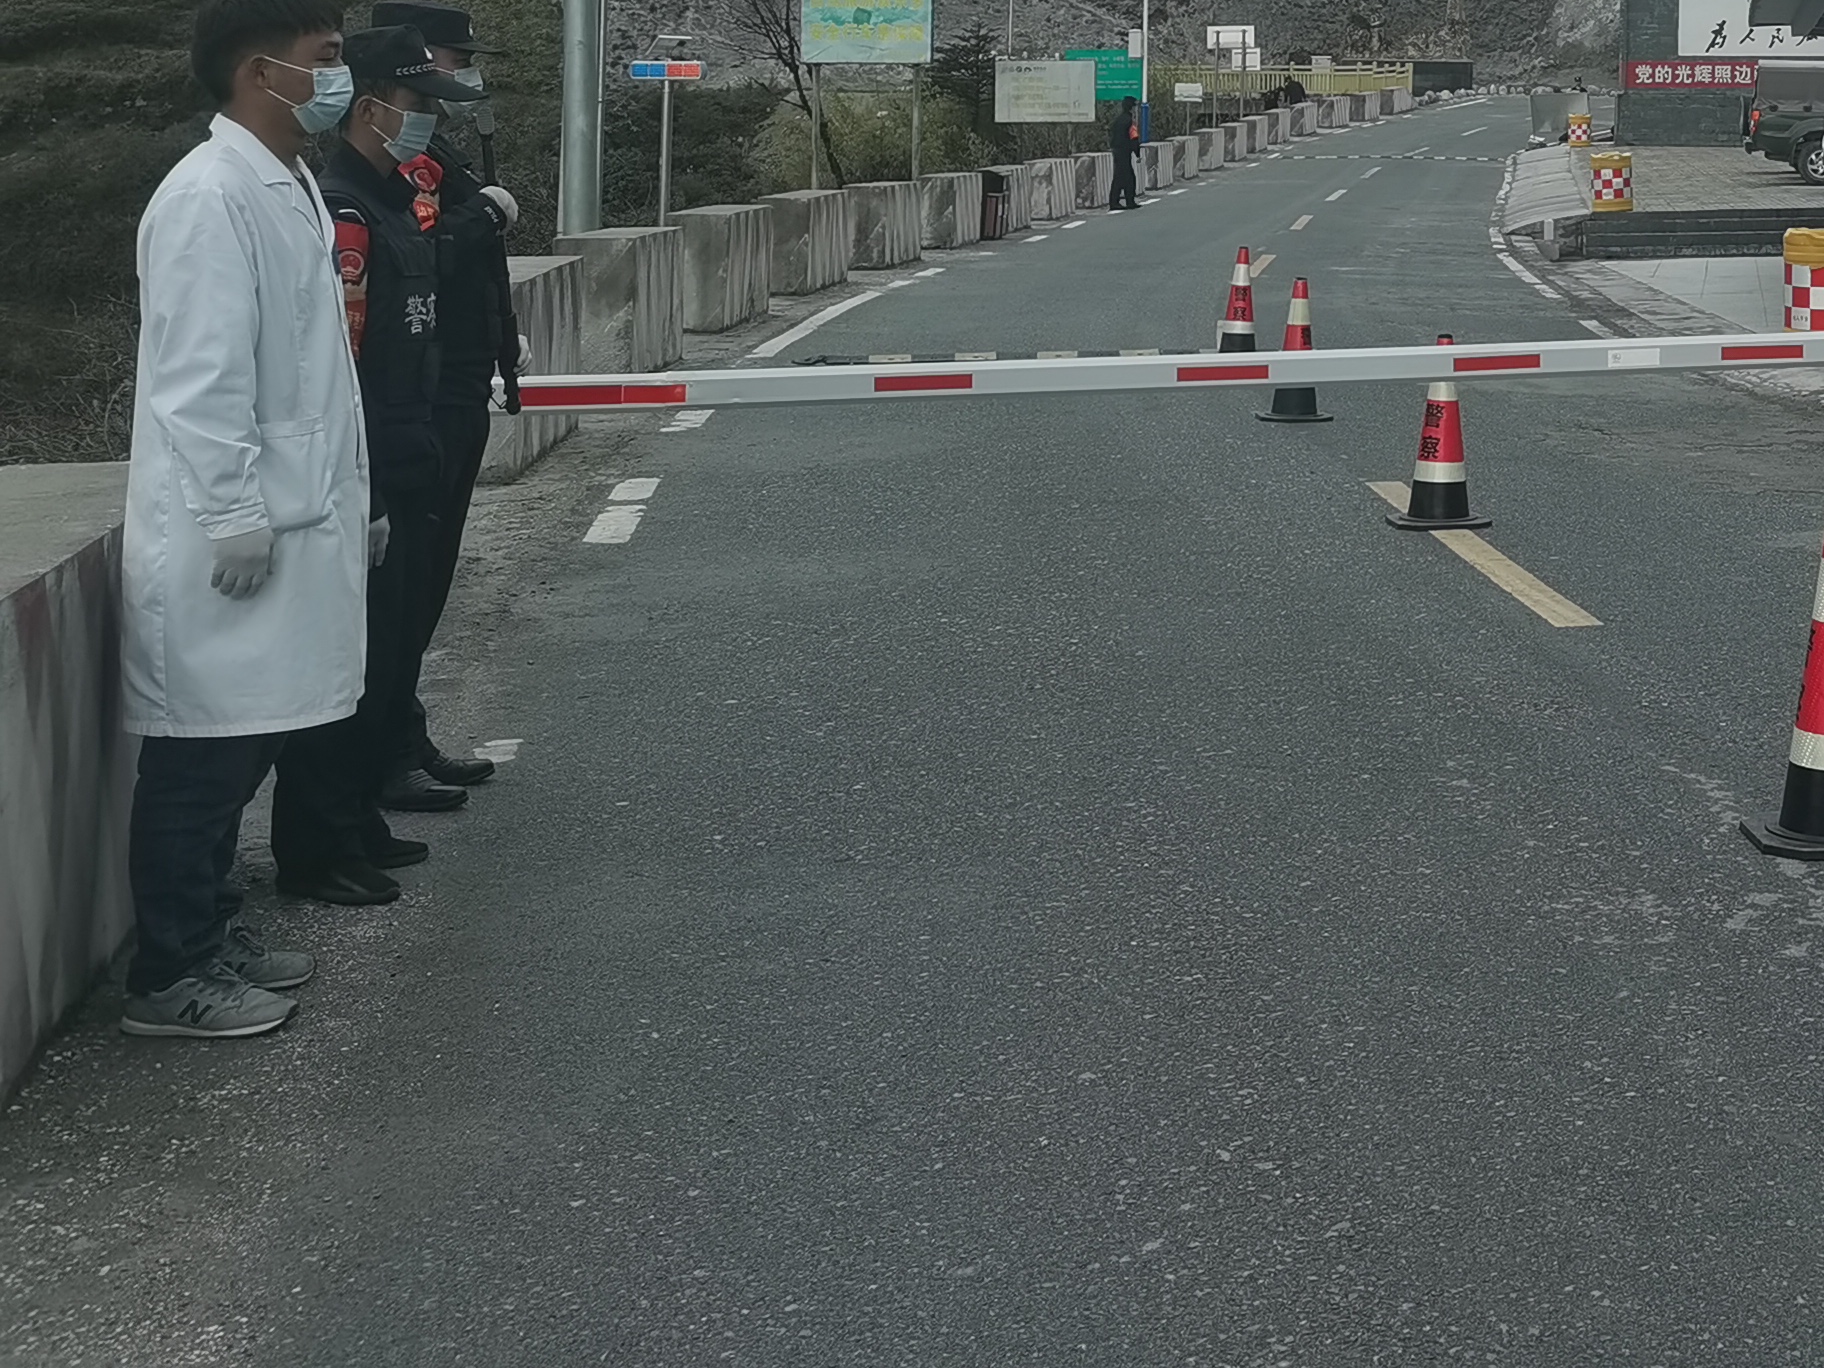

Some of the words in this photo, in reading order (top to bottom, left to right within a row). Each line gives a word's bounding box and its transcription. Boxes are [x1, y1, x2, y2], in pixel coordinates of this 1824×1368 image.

[1635, 64, 1759, 85] 党的光辉照边
[1419, 402, 1446, 460] 警察
[176, 998, 213, 1025] N
